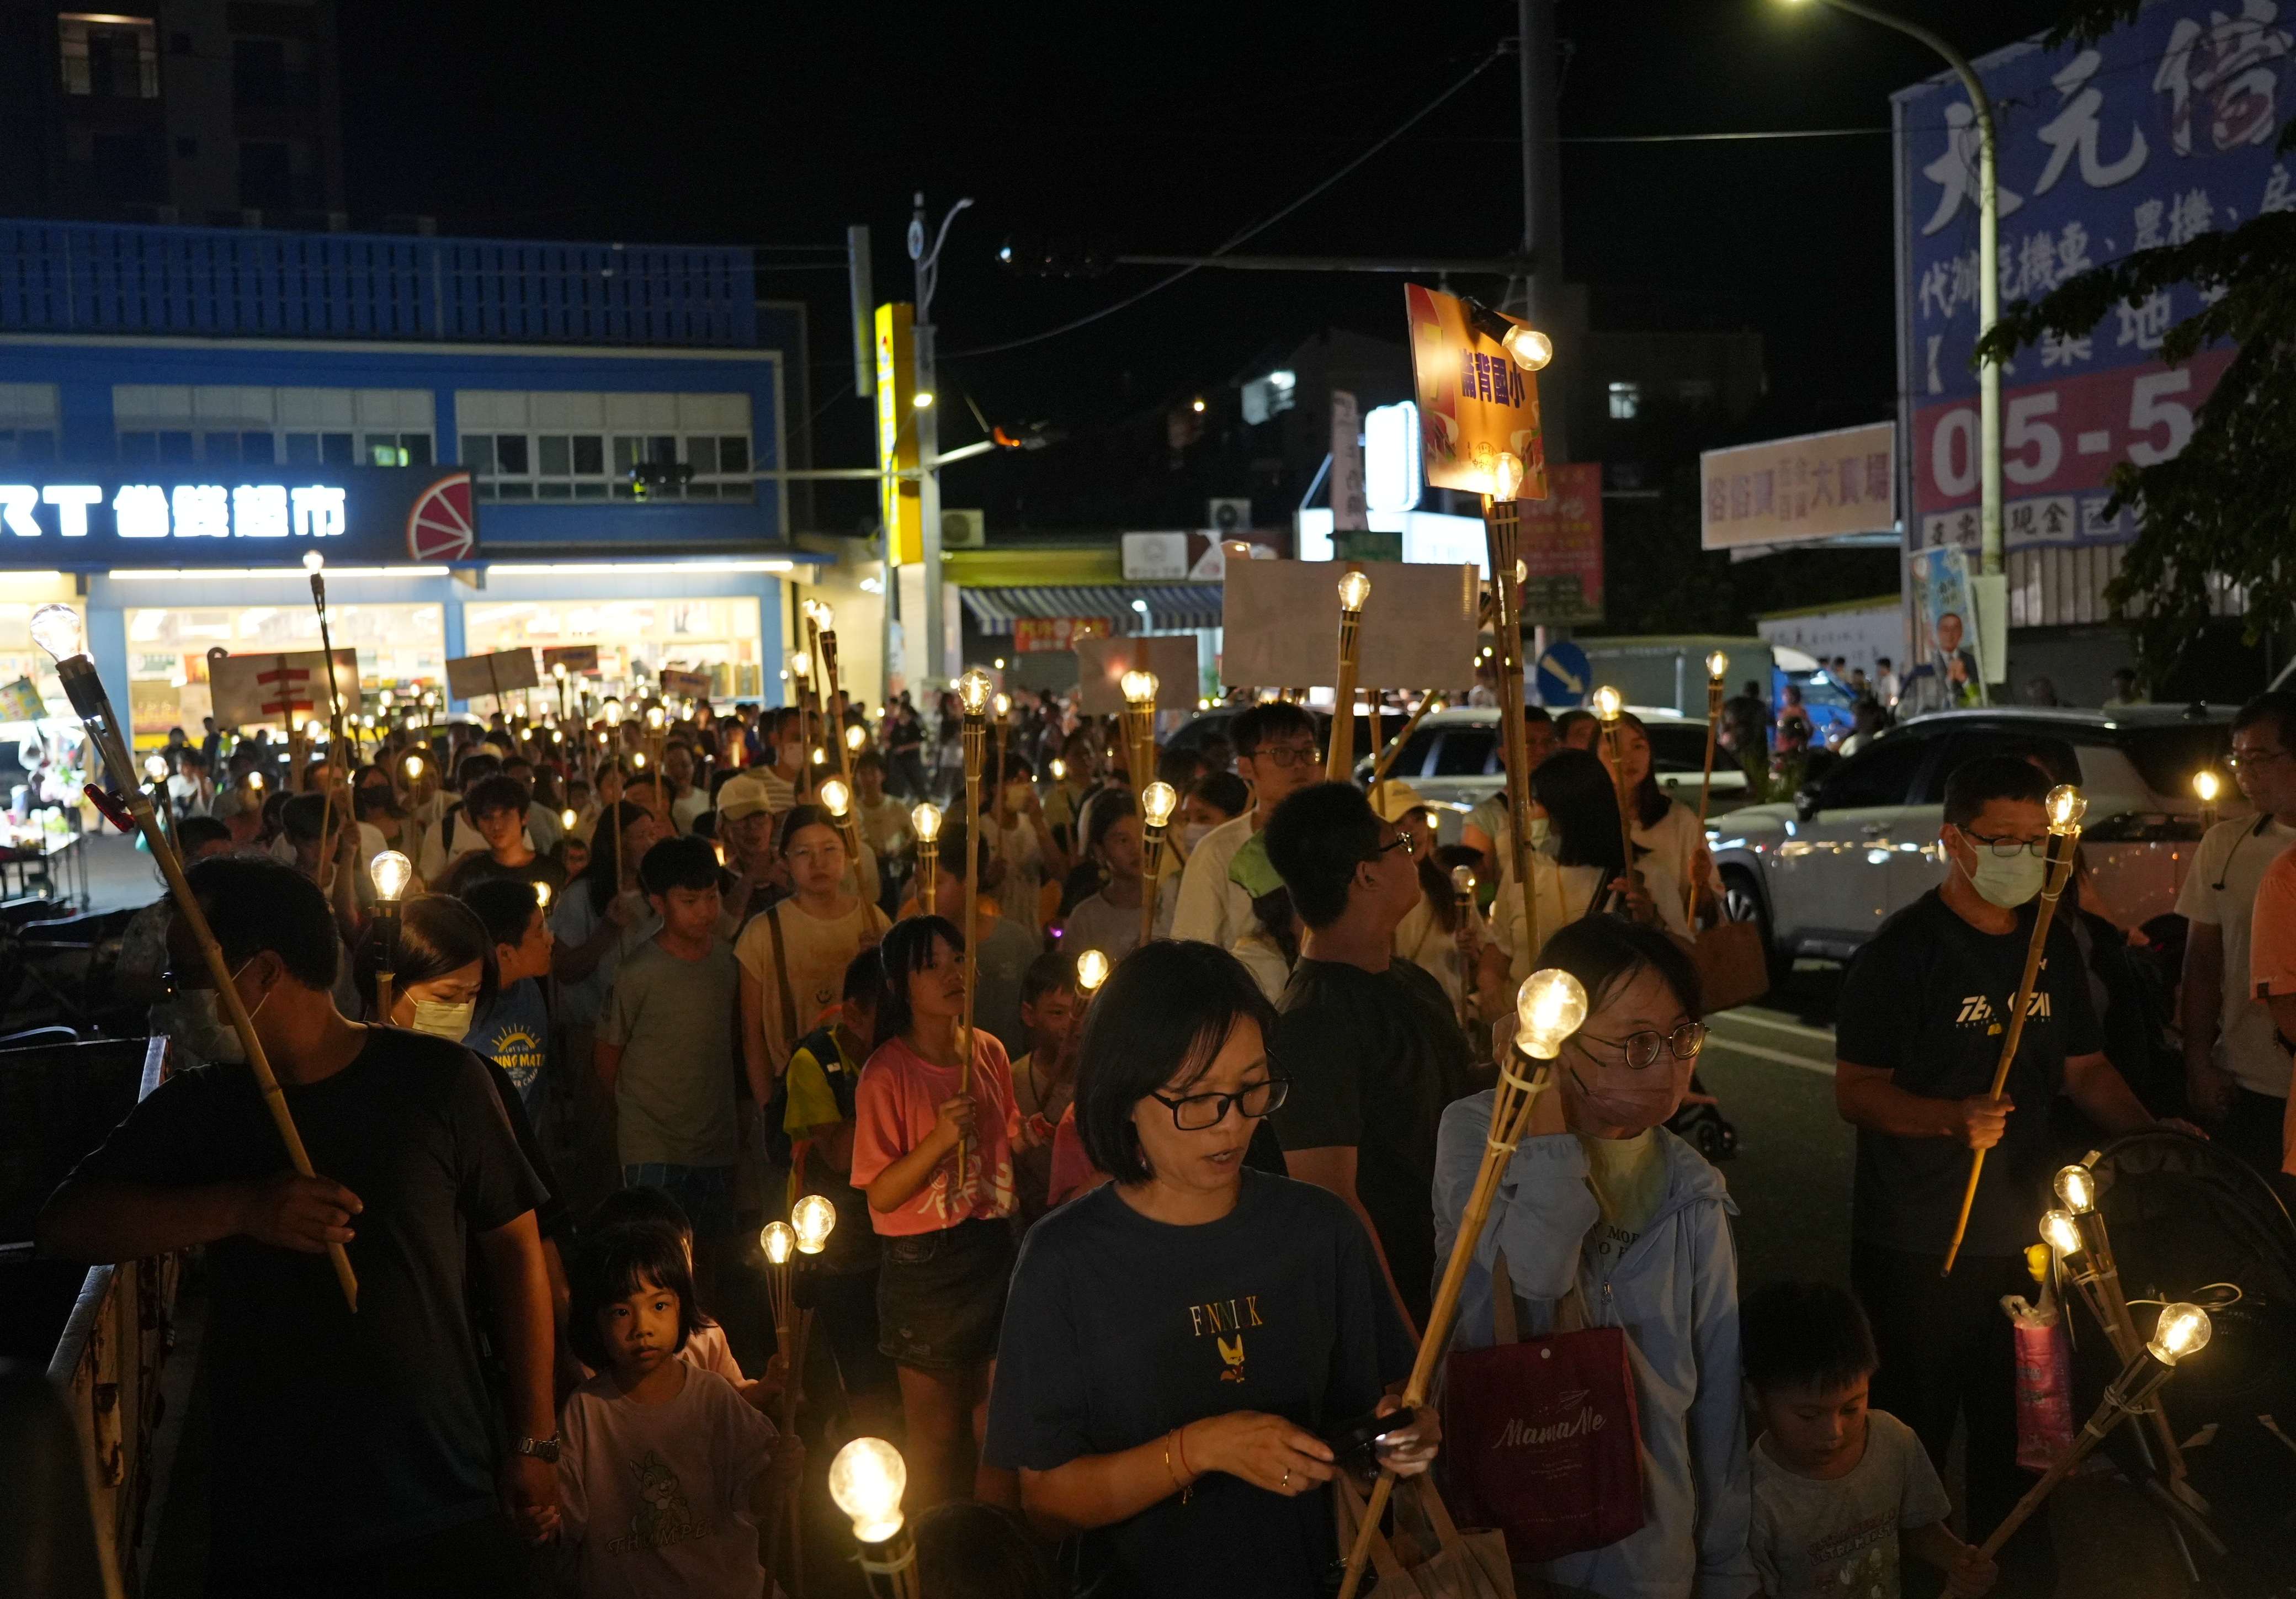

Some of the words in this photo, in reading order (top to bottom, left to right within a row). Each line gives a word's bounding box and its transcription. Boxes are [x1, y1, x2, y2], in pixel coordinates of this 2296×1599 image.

[1460, 348, 1526, 408] 崙背國小
[2011, 505, 2069, 536] 現金
[1491, 1405, 1608, 1449] MamaMe
